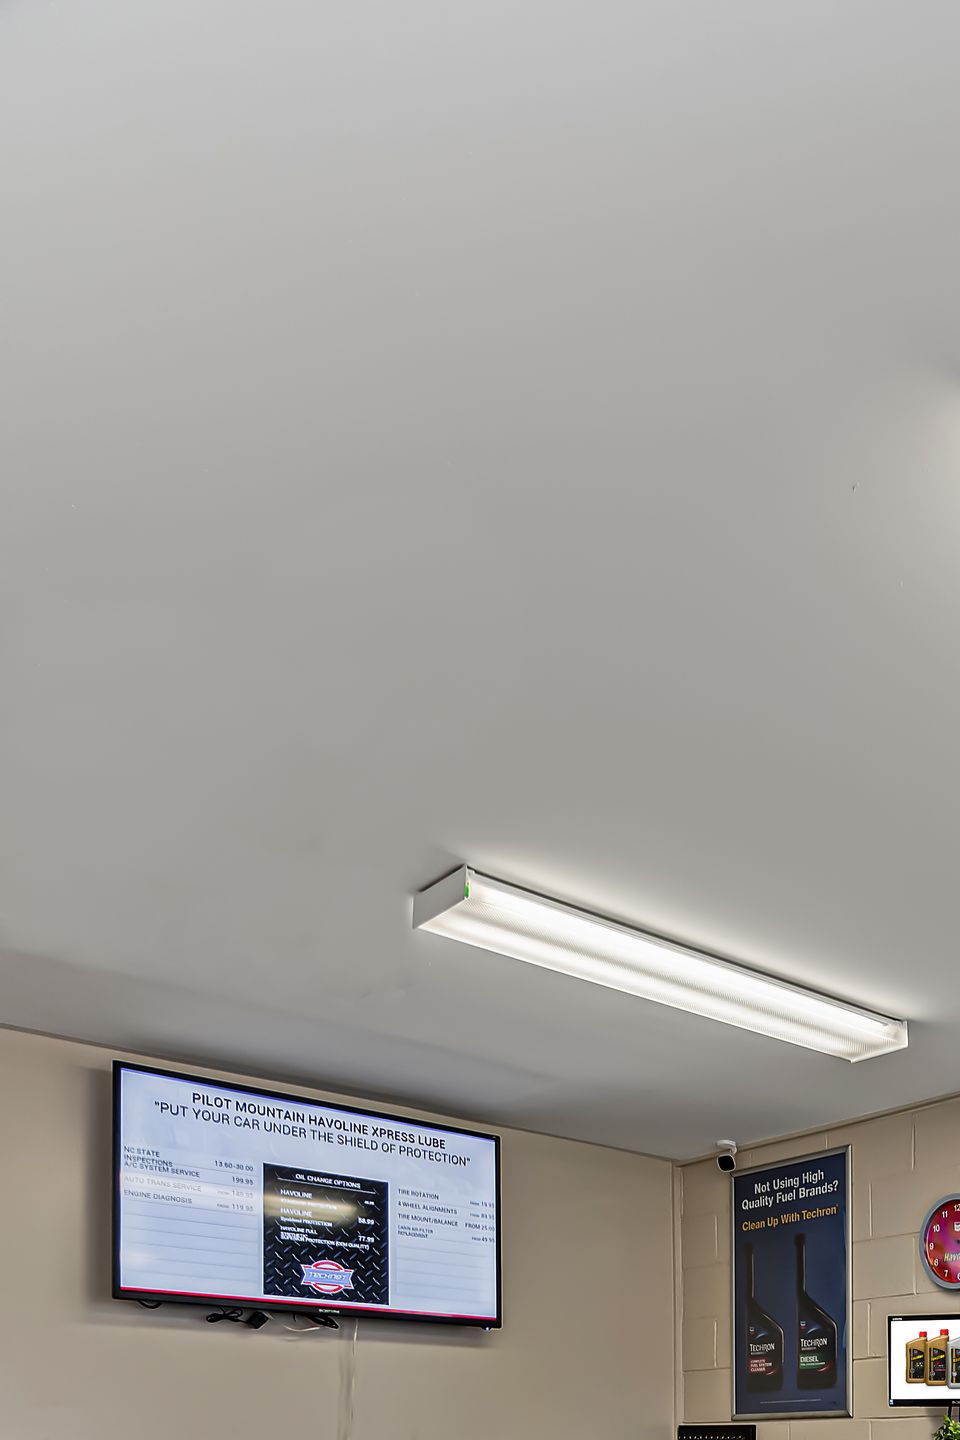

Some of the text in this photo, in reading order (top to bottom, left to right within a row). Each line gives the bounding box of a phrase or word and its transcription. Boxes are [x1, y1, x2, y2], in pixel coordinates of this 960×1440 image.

[192, 1092, 446, 1150] PILOT MOUNTAIN HAVOLINE XPRESS LUBE
[192, 1108, 230, 1125] YOUR
[233, 1116, 260, 1131] CAR
[263, 1121, 307, 1139] UNDER
[310, 1129, 334, 1143] THE
[337, 1134, 379, 1151] SHIELD
[381, 1142, 396, 1154] OF
[124, 1146, 160, 1158] NC STATE
[124, 1154, 173, 1167] INSPECTIONS
[139, 1164, 169, 1173] SYSTEM
[170, 1168, 200, 1178] SERVICE
[306, 1175, 333, 1185] CHANGE
[334, 1179, 361, 1189] OPTIONS
[754, 1169, 824, 1194] Not Using High
[124, 1189, 152, 1199] ENGINE
[153, 1193, 193, 1204] DIAGNOSIS
[280, 1189, 313, 1199] HAVOLINE
[741, 1180, 839, 1210] Quality Fuel Brands?
[280, 1207, 313, 1218] HAVOLINE
[742, 1205, 837, 1231] Clean Up With Techron
[942, 1210, 948, 1218] 11
[933, 1224, 940, 1233] 10
[929, 1242, 934, 1250] 9
[933, 1258, 939, 1267] 8
[944, 1269, 949, 1277] 7
